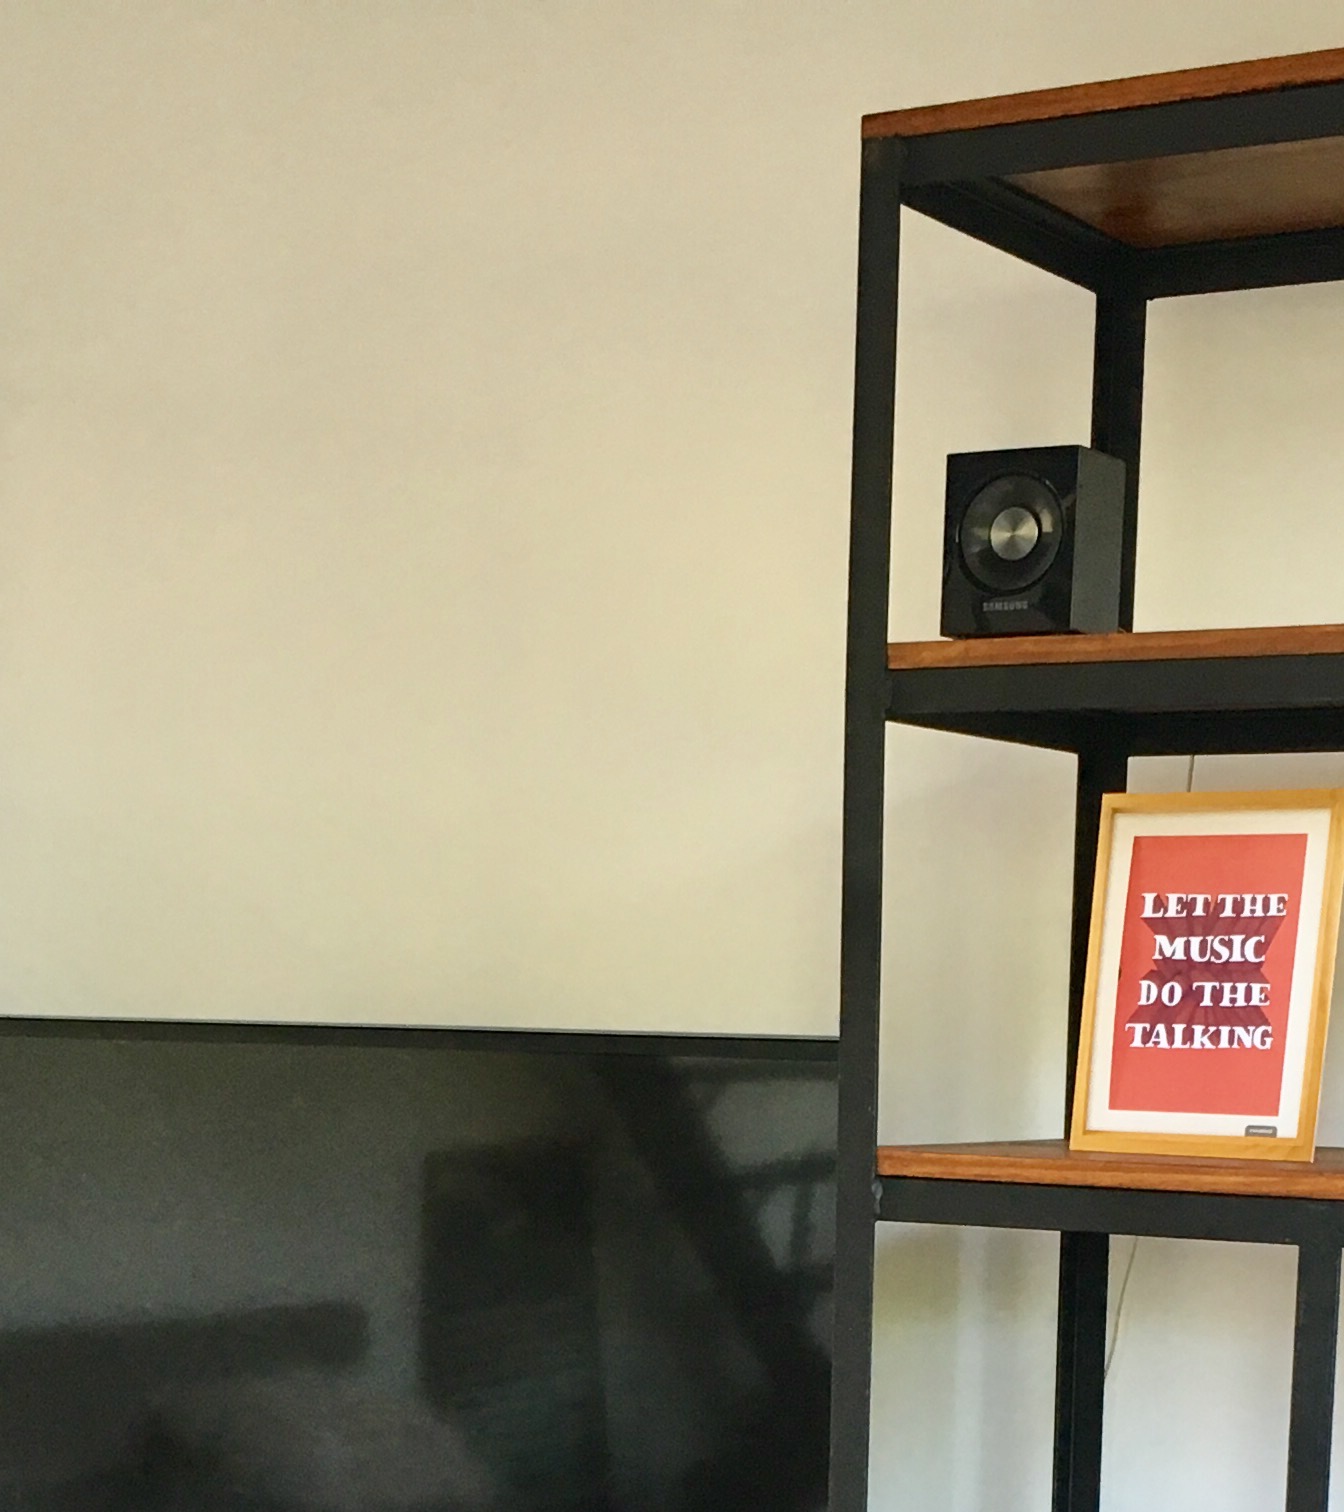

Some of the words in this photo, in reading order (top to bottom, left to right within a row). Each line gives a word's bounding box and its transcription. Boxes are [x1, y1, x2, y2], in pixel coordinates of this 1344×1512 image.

[982, 600, 1029, 612] SAMSUNG
[1140, 892, 1211, 919] LET
[1217, 892, 1289, 918] THE
[1152, 934, 1266, 964] MUSIC
[1137, 980, 1183, 1007] DO
[1192, 981, 1271, 1008] THE
[1125, 1022, 1274, 1051] TALKING
